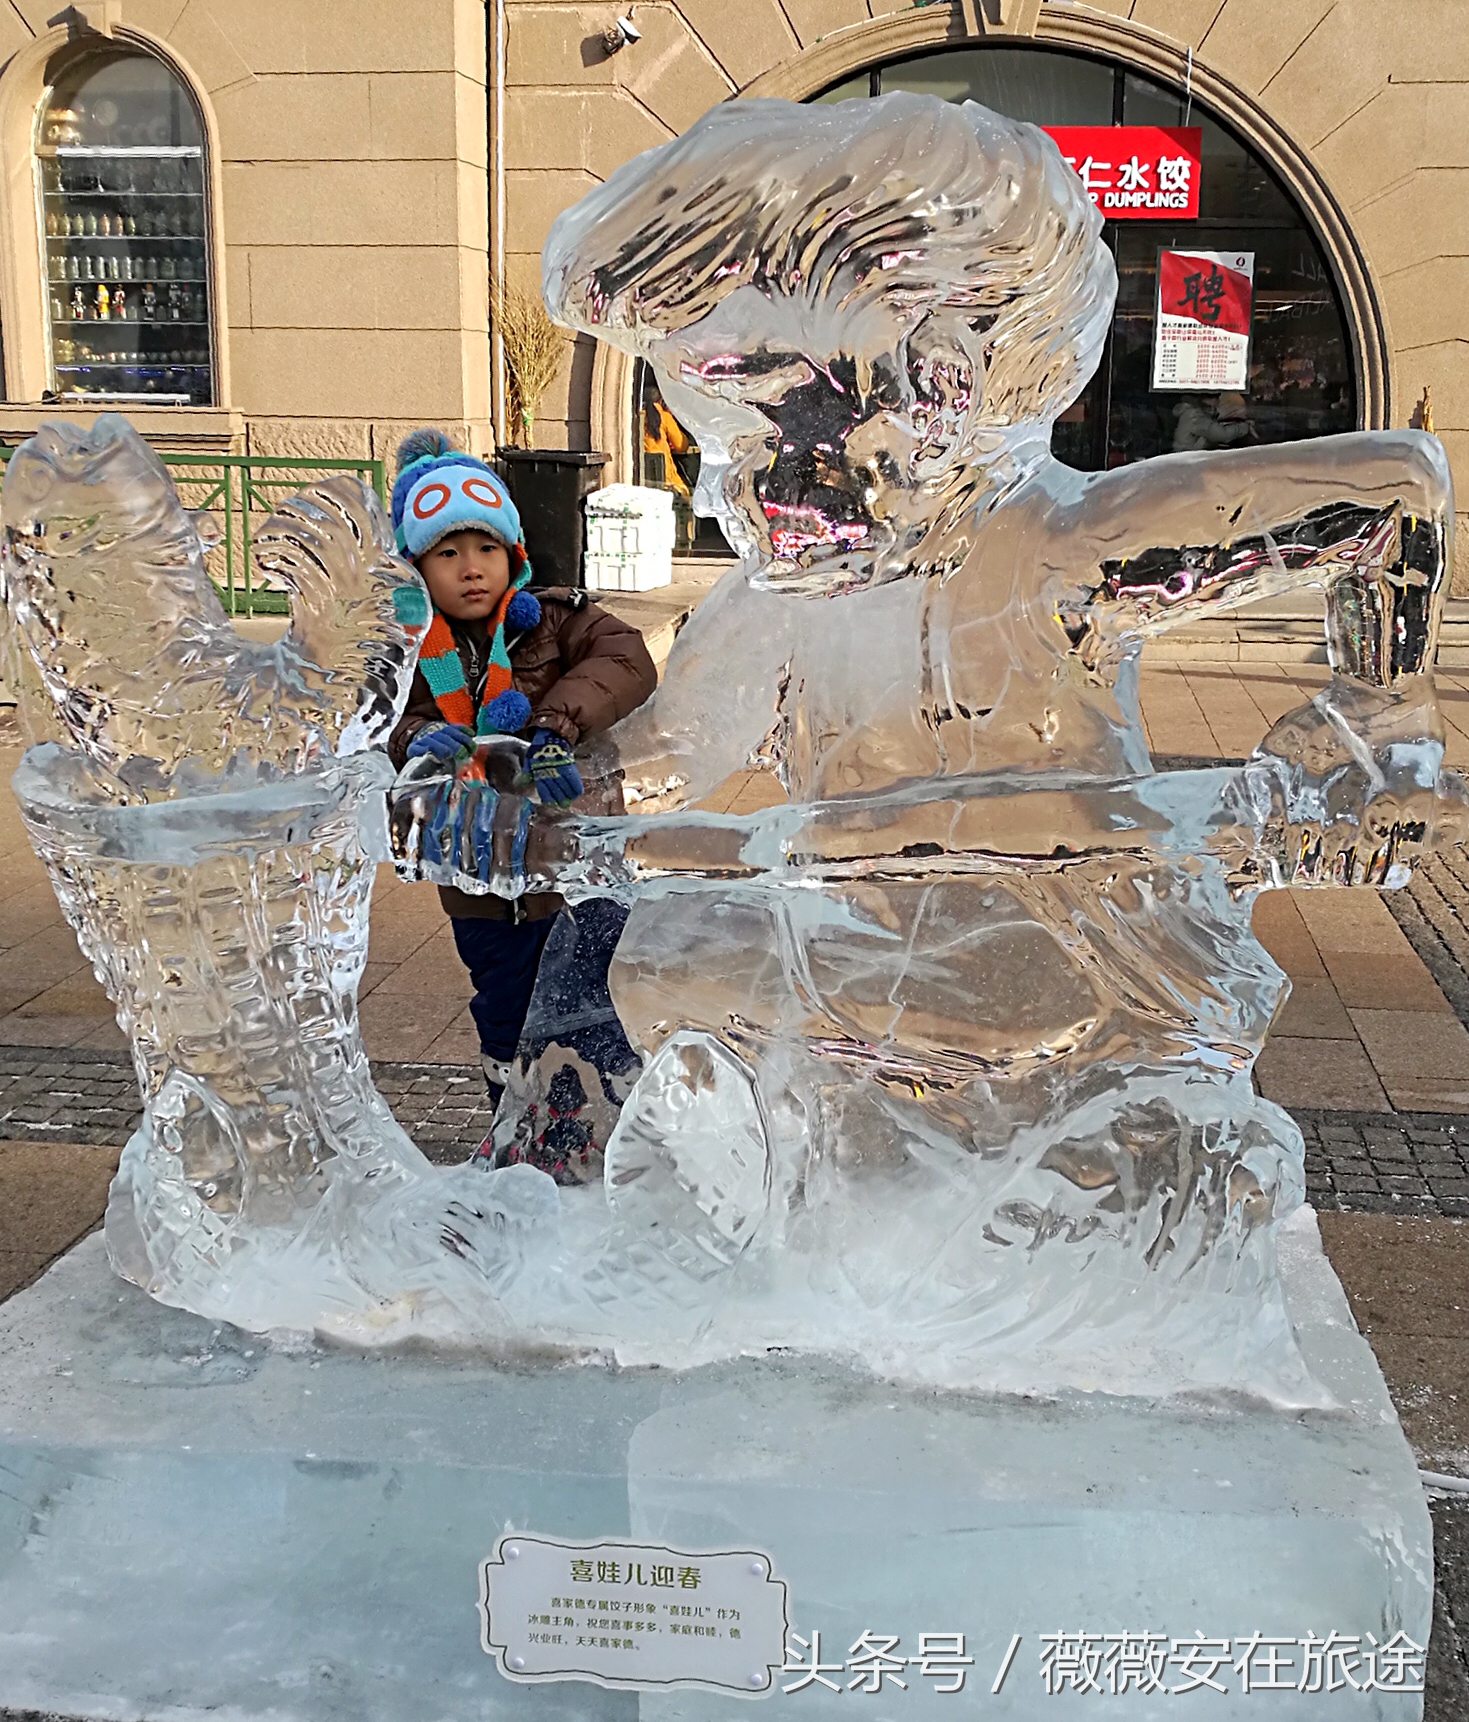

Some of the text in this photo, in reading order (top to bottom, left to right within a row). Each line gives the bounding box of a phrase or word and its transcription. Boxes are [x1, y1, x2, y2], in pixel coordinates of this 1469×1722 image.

[1064, 155, 1191, 191] 仁水饺
[1104, 191, 1189, 208] DUMPLINGS
[1177, 263, 1225, 321] 聘
[570, 1559, 702, 1589] 喜娃儿迎春
